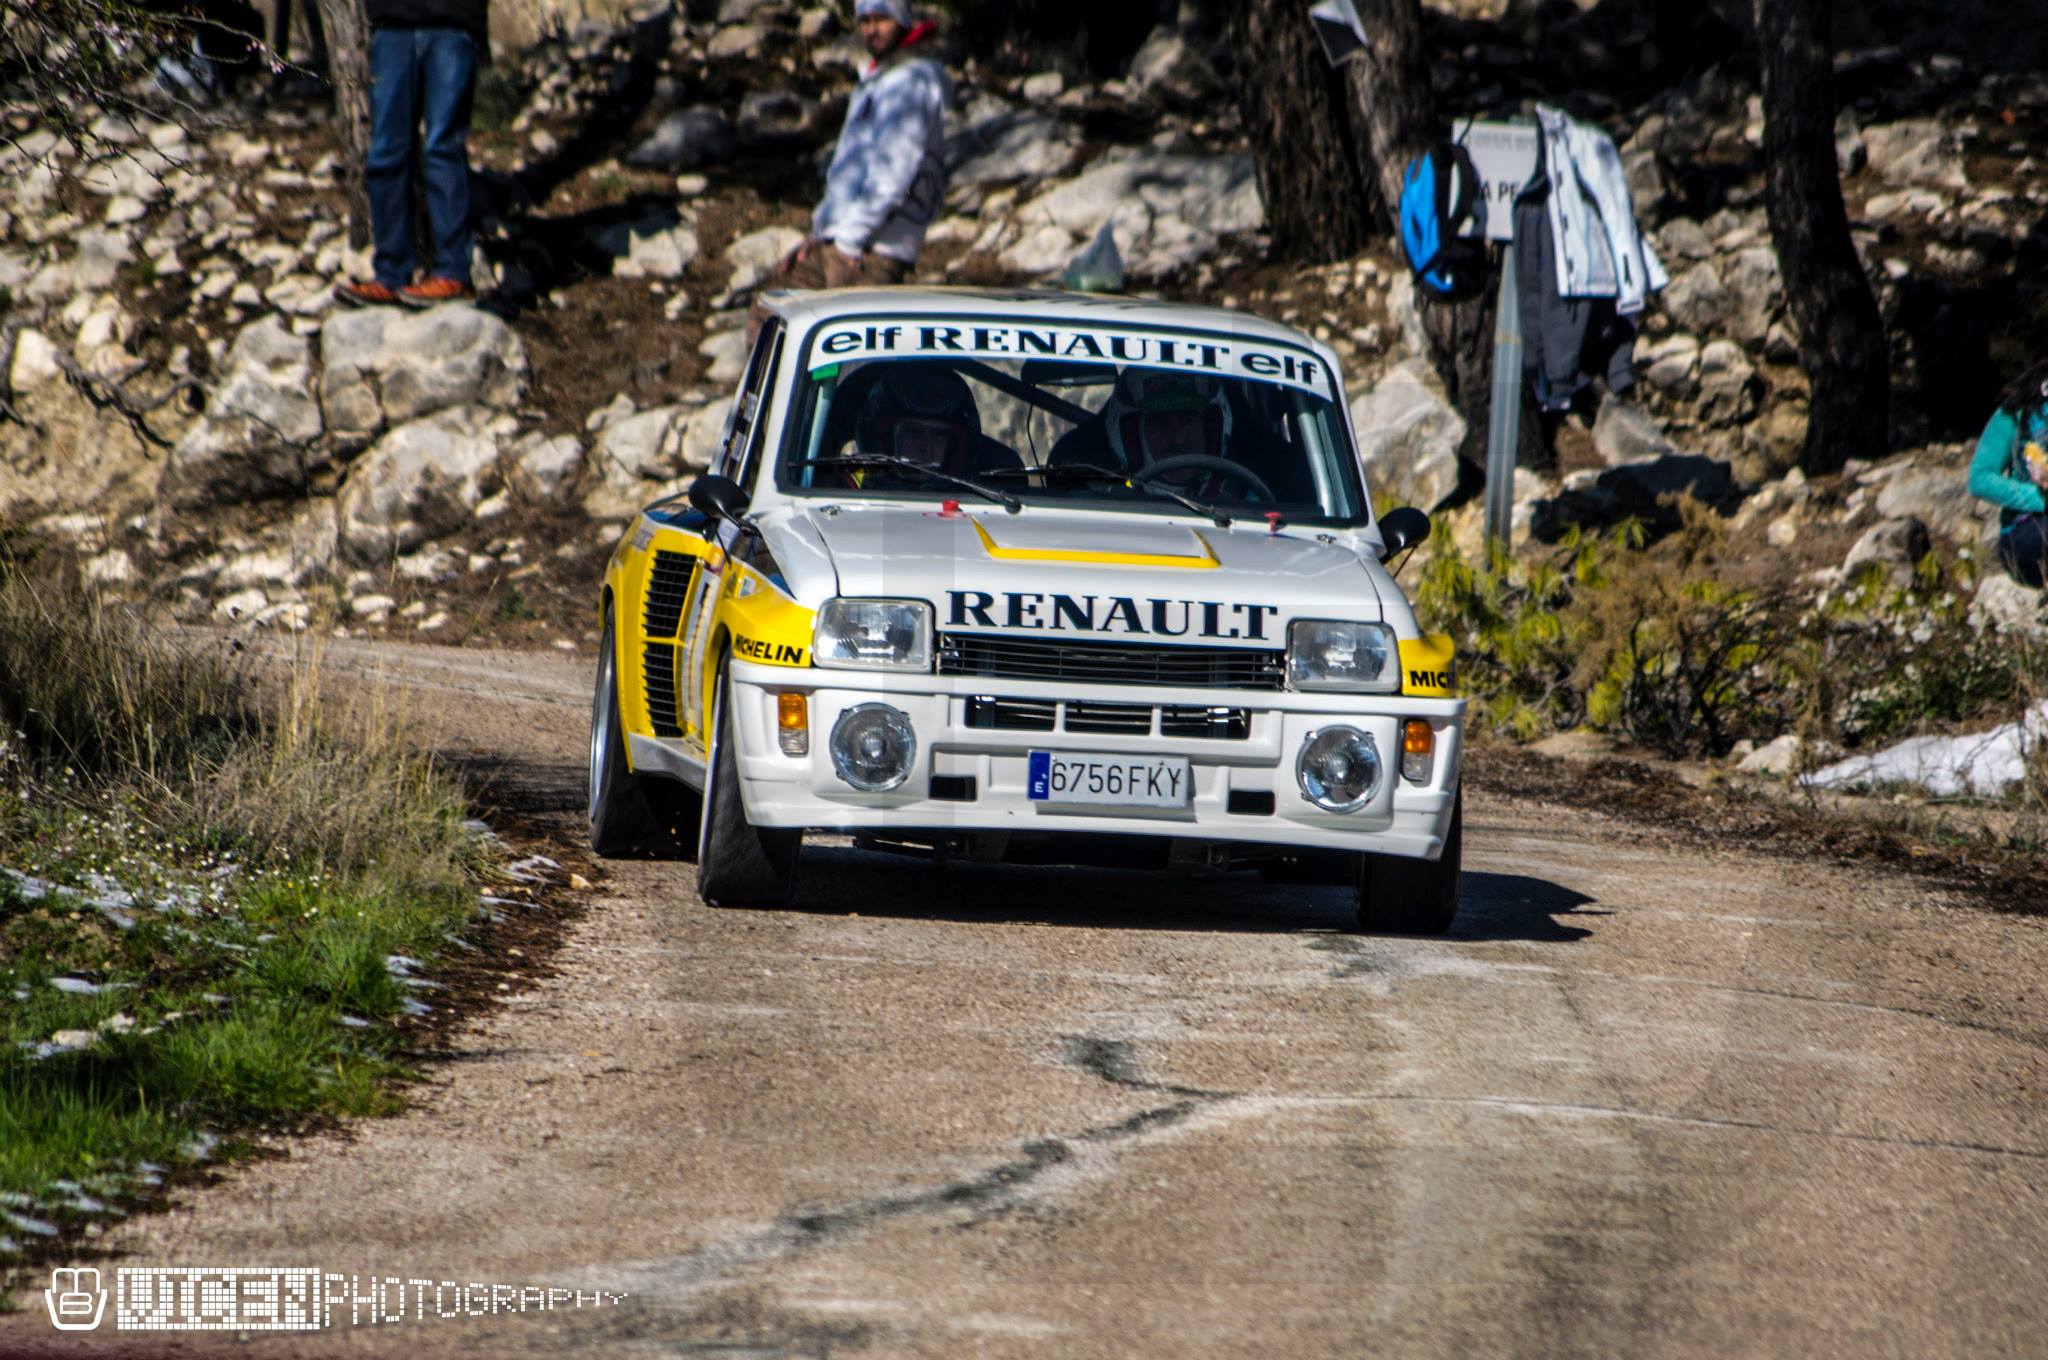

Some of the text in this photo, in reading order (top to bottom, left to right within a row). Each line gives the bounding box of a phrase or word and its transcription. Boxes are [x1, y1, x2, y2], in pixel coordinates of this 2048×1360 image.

[821, 326, 1317, 385] elf RENAULT elf
[945, 590, 1278, 641] RENAULT
[735, 633, 804, 664] MICHELIN
[1409, 670, 1452, 689] MIC
[1051, 762, 1181, 798] 6756FKY
